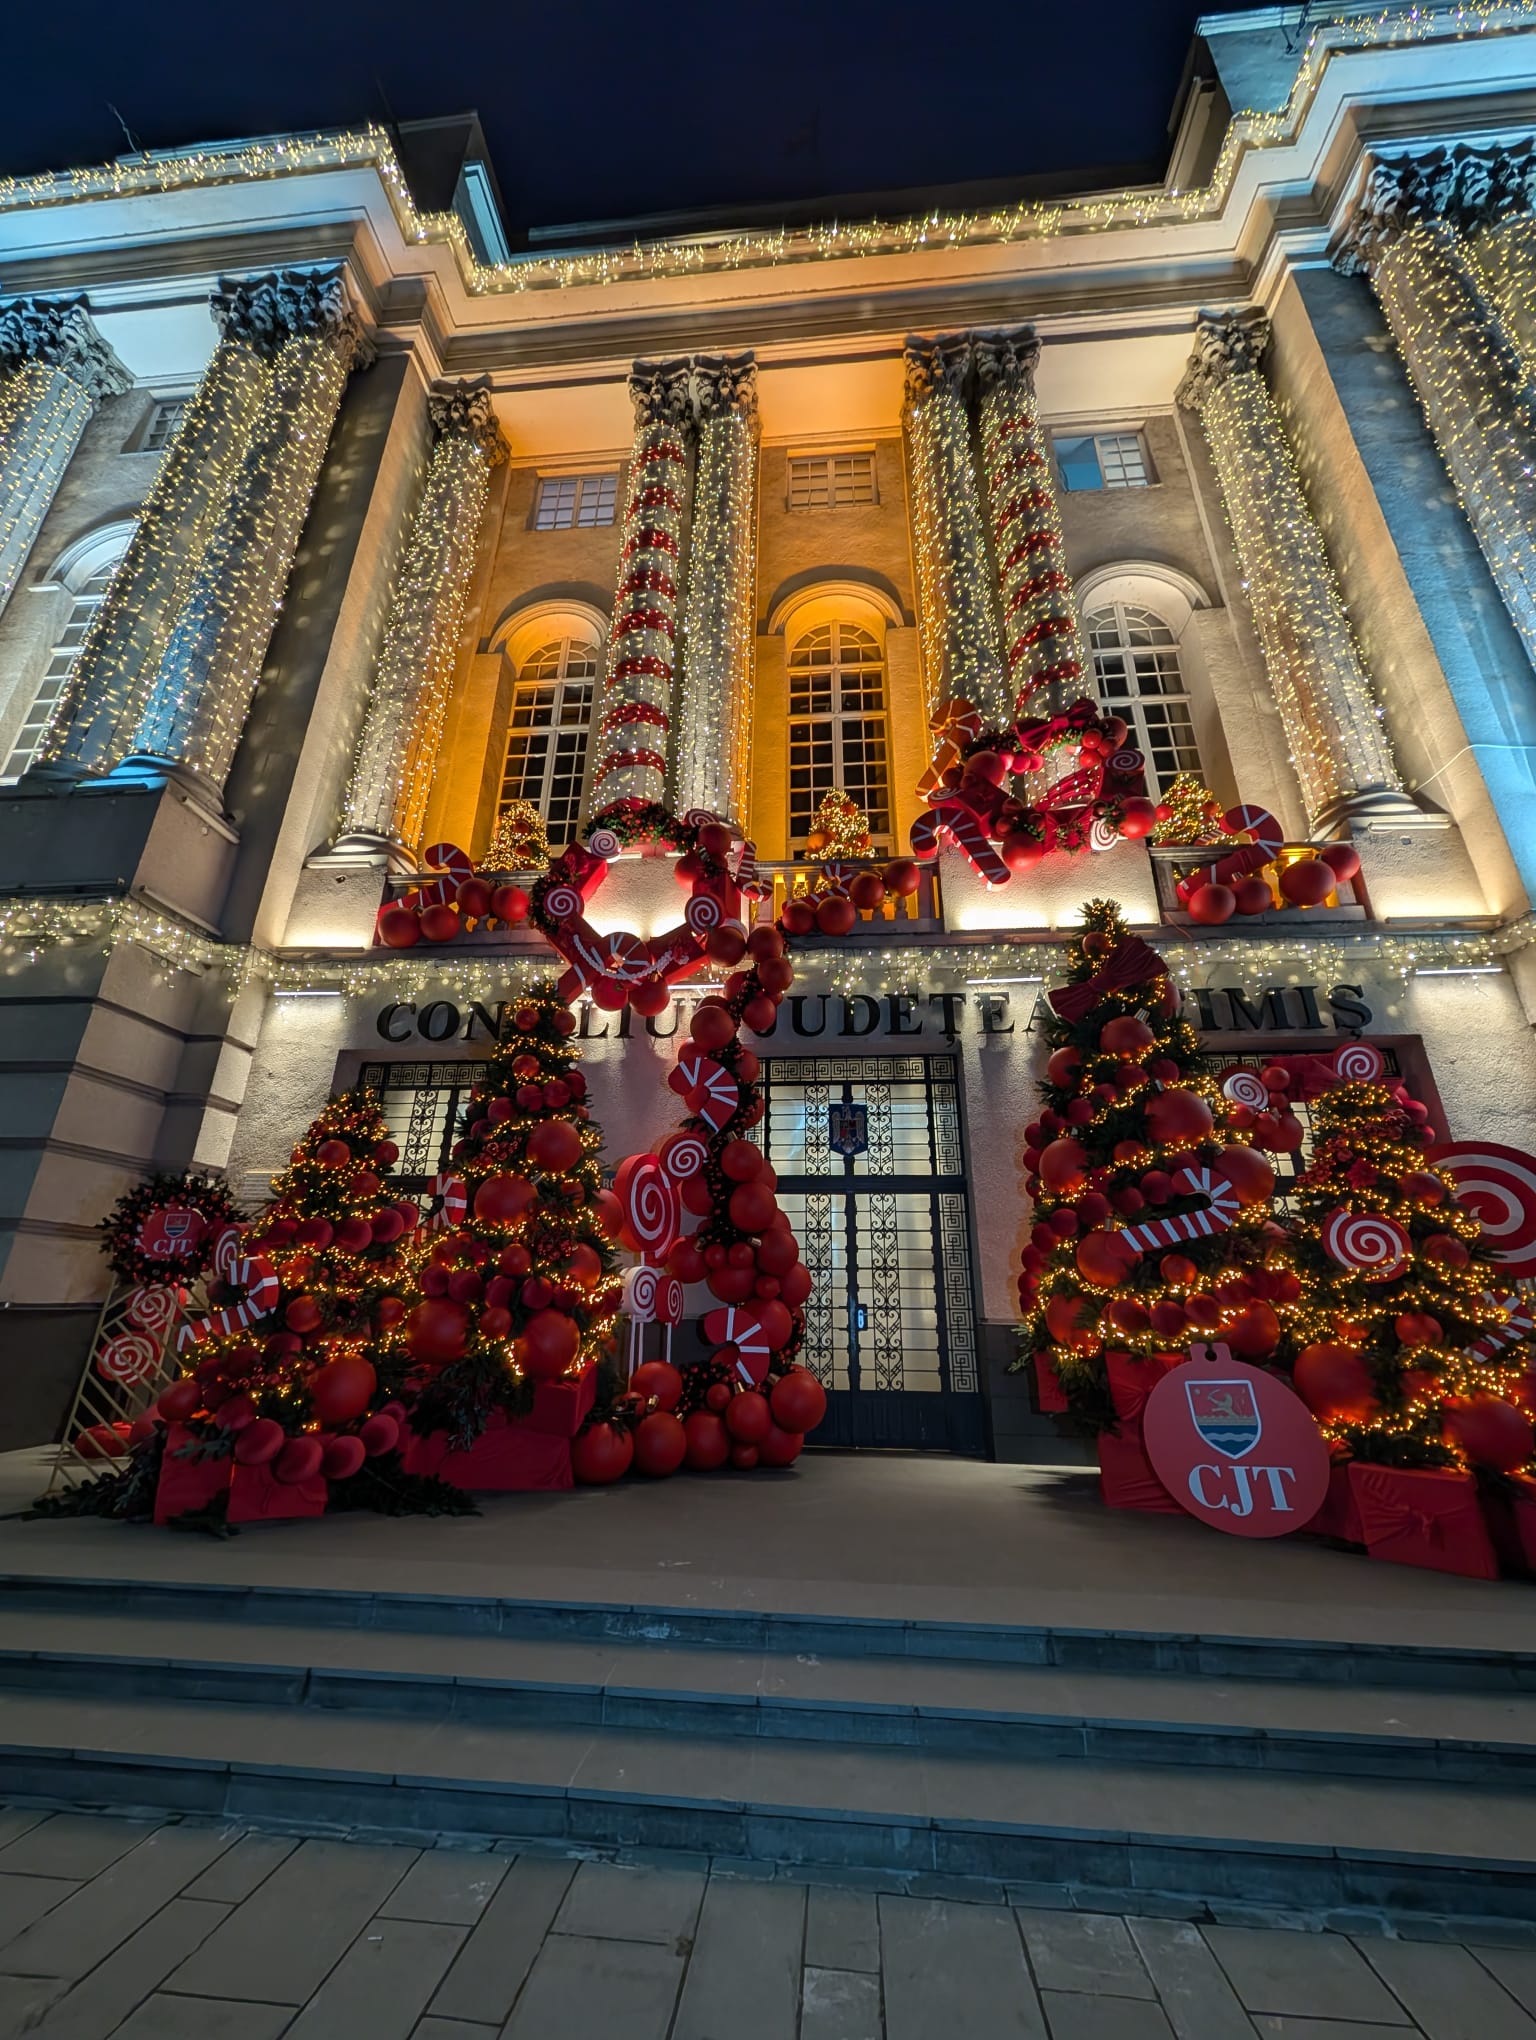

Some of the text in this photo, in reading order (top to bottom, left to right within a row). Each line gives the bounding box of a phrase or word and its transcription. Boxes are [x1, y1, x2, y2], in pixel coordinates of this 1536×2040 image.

[1179, 984, 1373, 1041] IMIȘ
[153, 1239, 192, 1255] CJT
[1188, 1464, 1296, 1516] CJT
